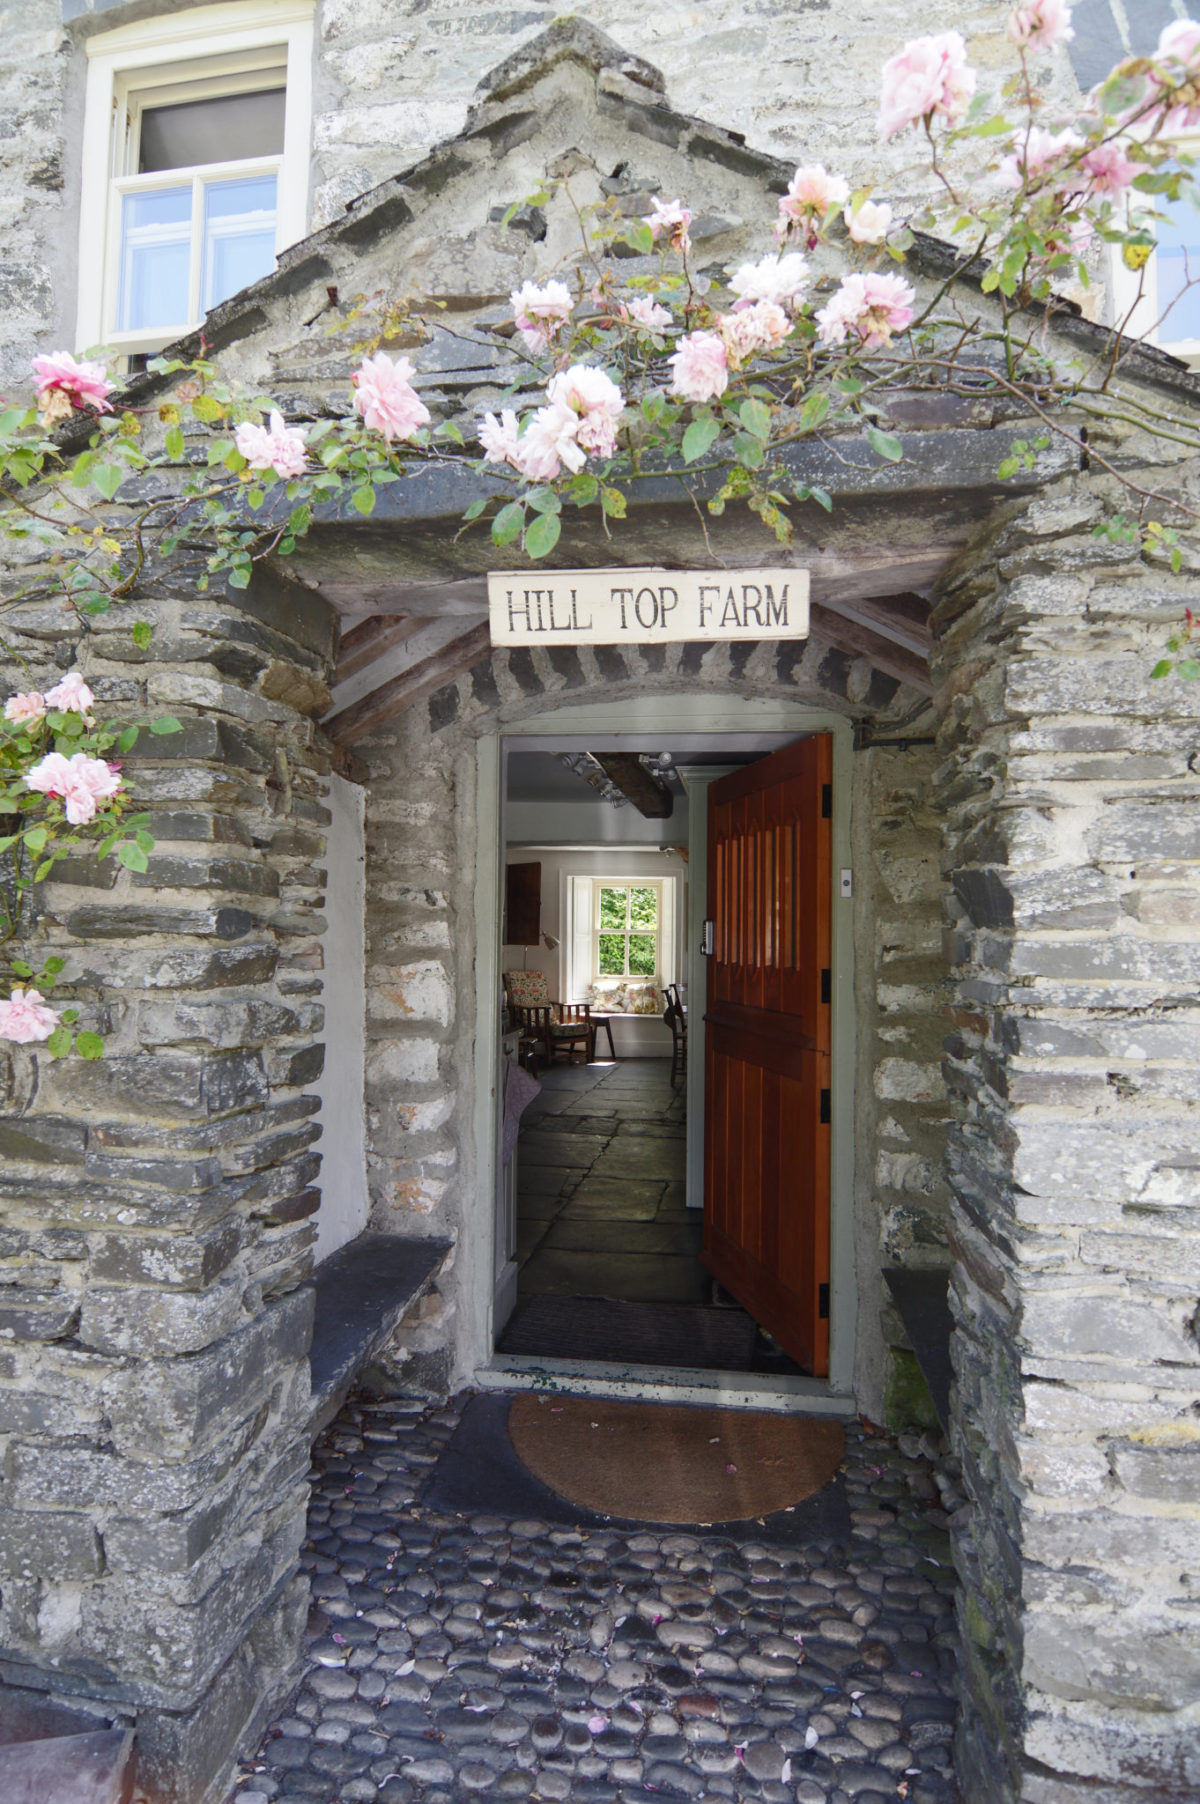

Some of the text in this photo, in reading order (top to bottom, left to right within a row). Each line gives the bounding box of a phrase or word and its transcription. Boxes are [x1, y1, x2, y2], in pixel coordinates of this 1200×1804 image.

[506, 584, 791, 632] HILL TOP FARM
